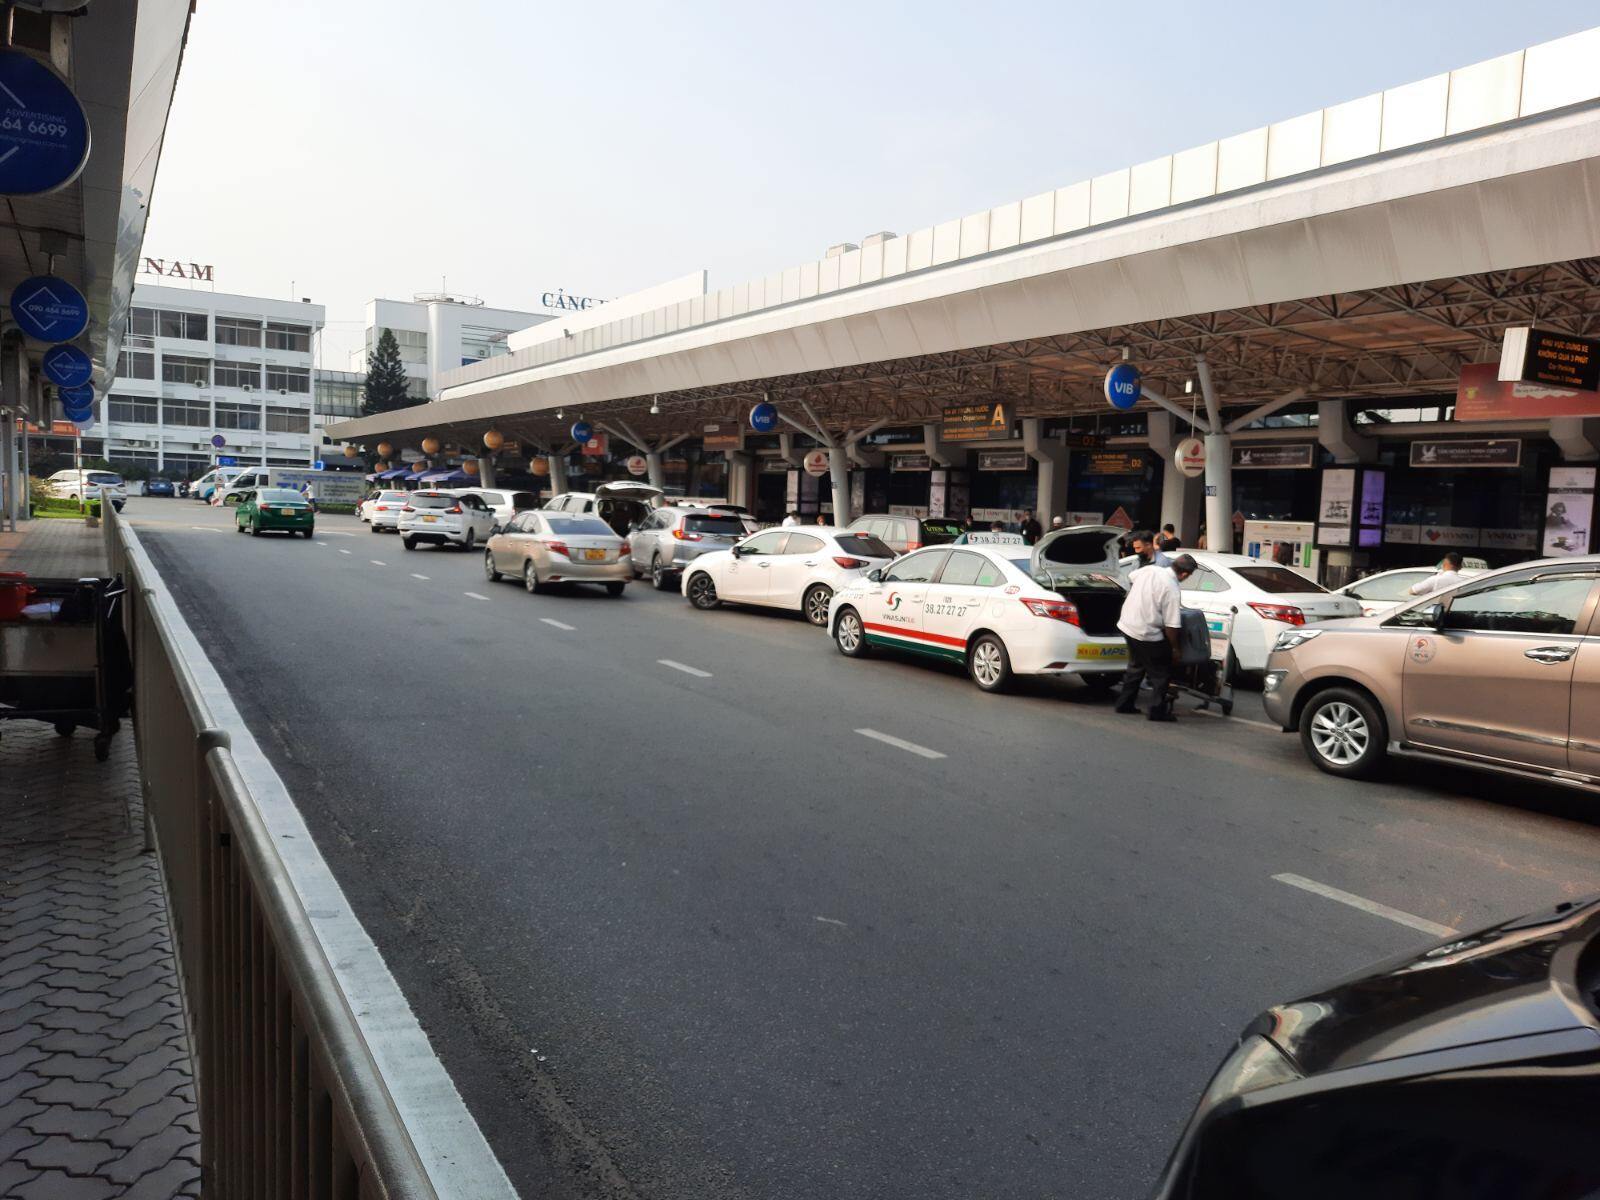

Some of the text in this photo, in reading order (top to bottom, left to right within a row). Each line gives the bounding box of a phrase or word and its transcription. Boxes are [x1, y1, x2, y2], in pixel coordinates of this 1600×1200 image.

[28, 121, 68, 137] 6699
[144, 257, 214, 281] NAM
[1114, 381, 1134, 395] VIB
[755, 415, 770, 424] VIB
[991, 402, 1005, 427] A
